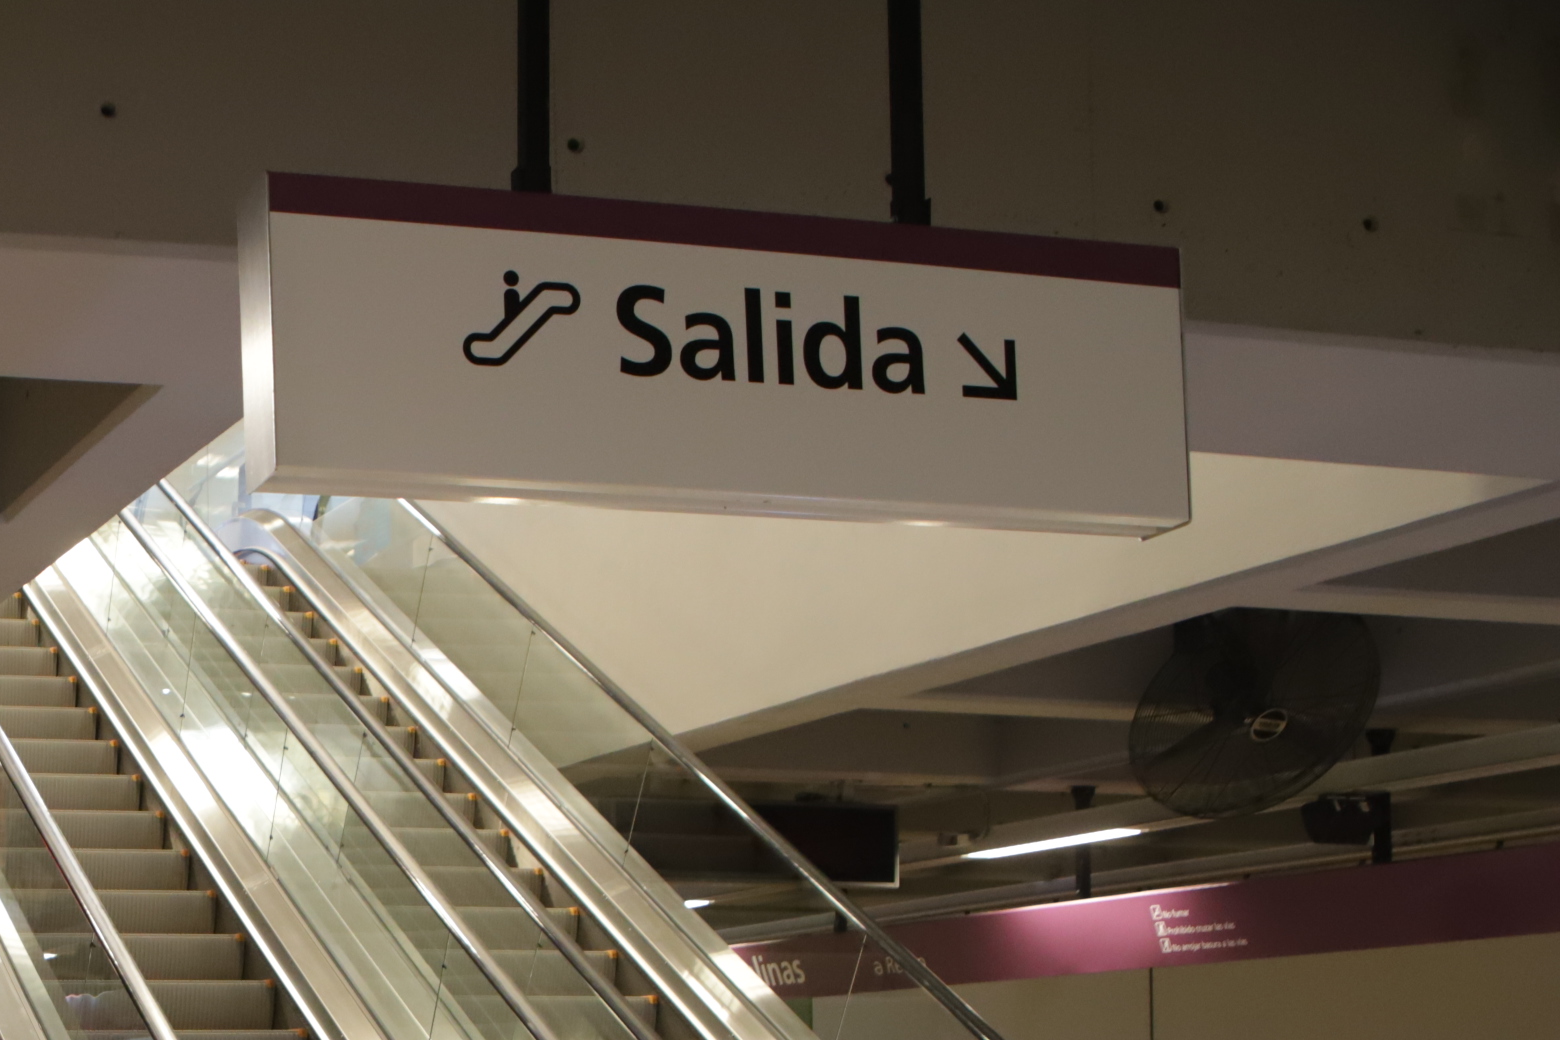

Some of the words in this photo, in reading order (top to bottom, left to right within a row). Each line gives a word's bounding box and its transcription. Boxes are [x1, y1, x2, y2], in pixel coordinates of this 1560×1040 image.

[616, 284, 926, 395] Salida
[752, 954, 806, 987] linas
[873, 961, 883, 975] a
